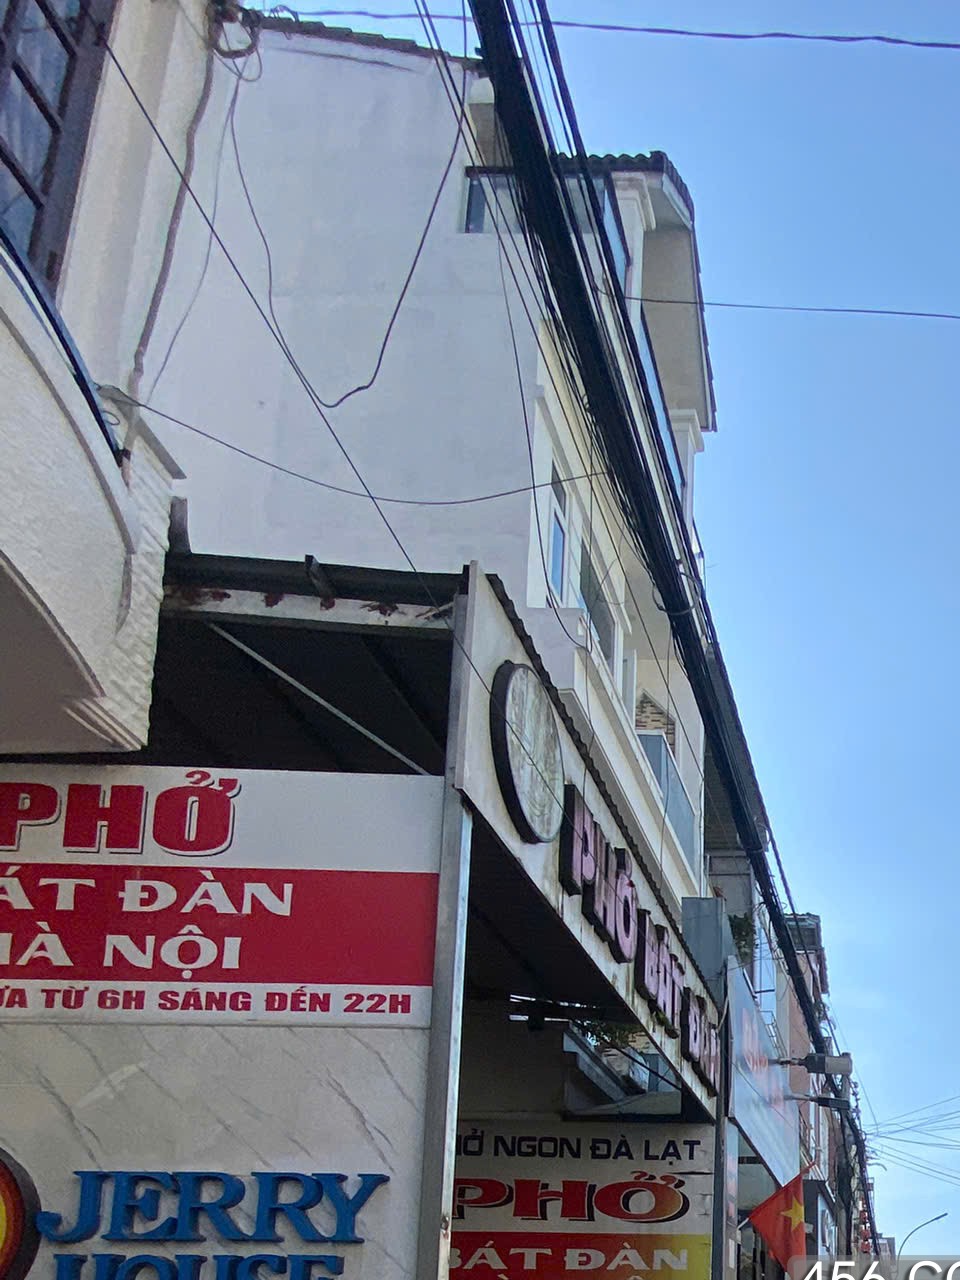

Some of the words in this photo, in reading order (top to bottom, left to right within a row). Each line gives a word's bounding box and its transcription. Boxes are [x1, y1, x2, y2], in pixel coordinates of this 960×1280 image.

[0, 770, 242, 856] PHỞ
[118, 870, 293, 916] ĐÀN
[559, 783, 638, 964] PHỞ
[0, 921, 74, 966] À
[103, 924, 241, 979] NỘI
[41, 985, 90, 1010] TỪ
[97, 989, 145, 1011] 6H
[158, 985, 251, 1012] SÁNG
[264, 985, 331, 1013] ĐẾN
[343, 993, 412, 1014] 22H
[494, 1135, 581, 1158] NGON
[590, 1134, 634, 1161] ĐÀ
[644, 1139, 701, 1166] LẠT
[36, 1170, 391, 1244] JERRY
[451, 1171, 690, 1223] PHỞ
[563, 1241, 688, 1270] ĐÀN
